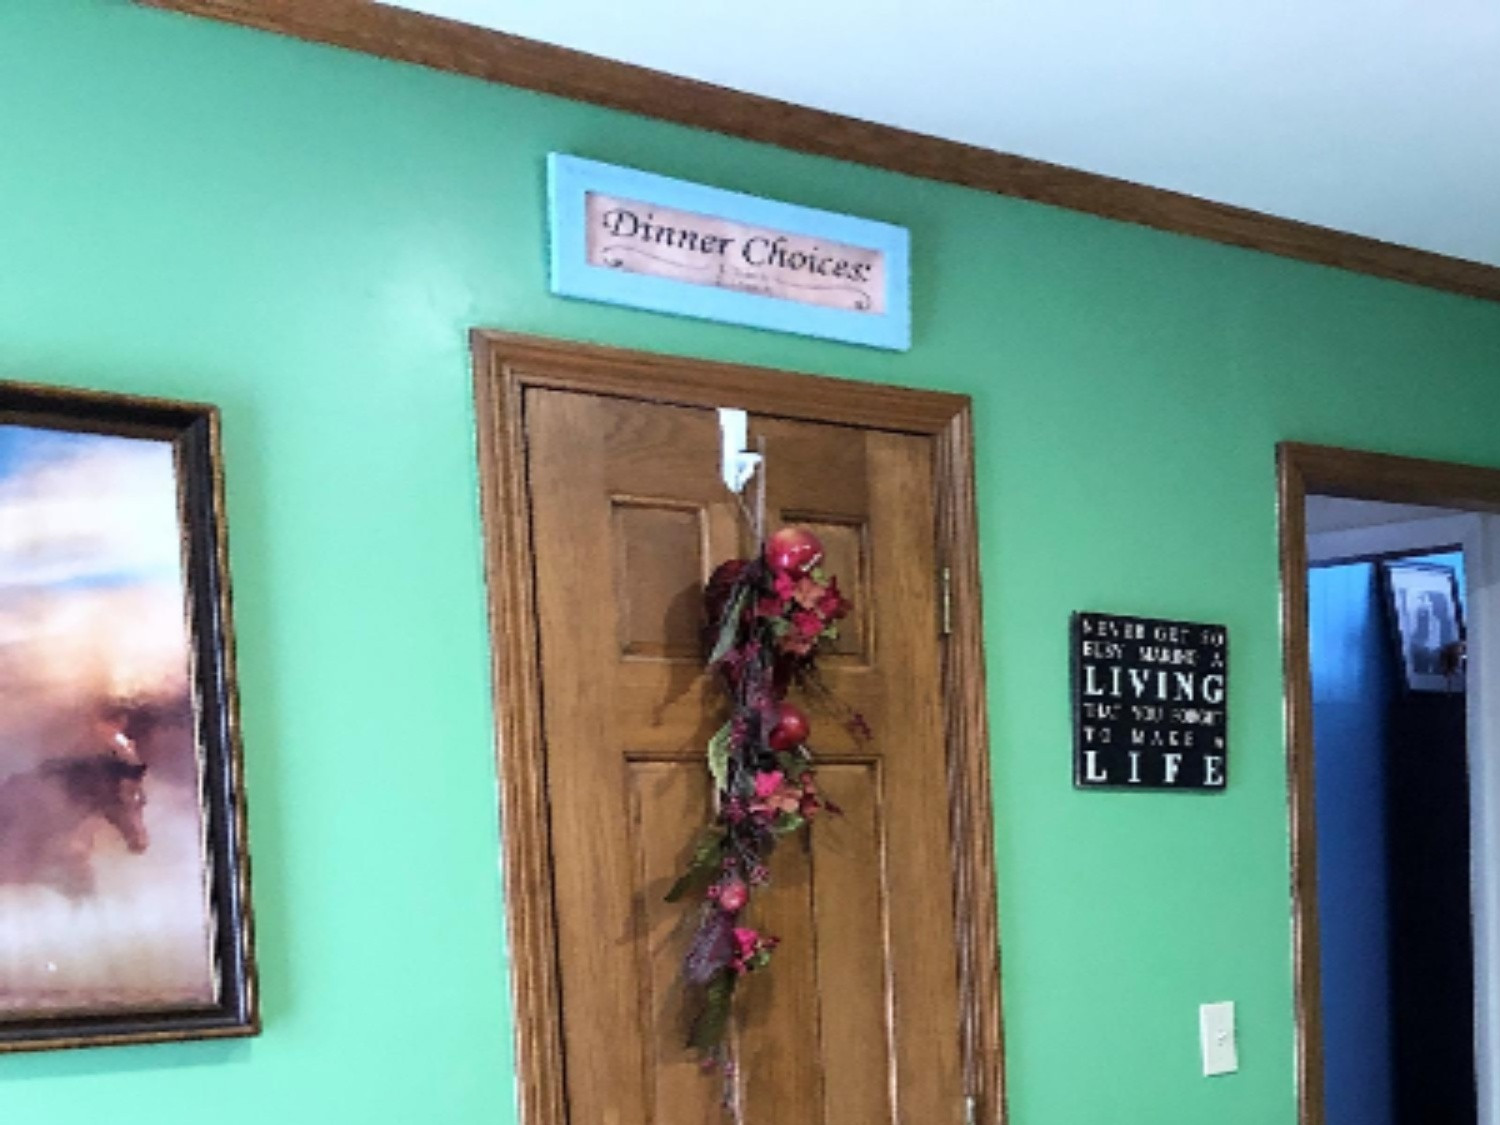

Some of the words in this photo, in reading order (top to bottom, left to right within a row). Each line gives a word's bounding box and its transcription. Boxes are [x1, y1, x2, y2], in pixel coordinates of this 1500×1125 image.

[602, 207, 735, 256] Dinner
[1084, 665, 1225, 704] LIVING
[1084, 751, 1224, 786] LIFE
